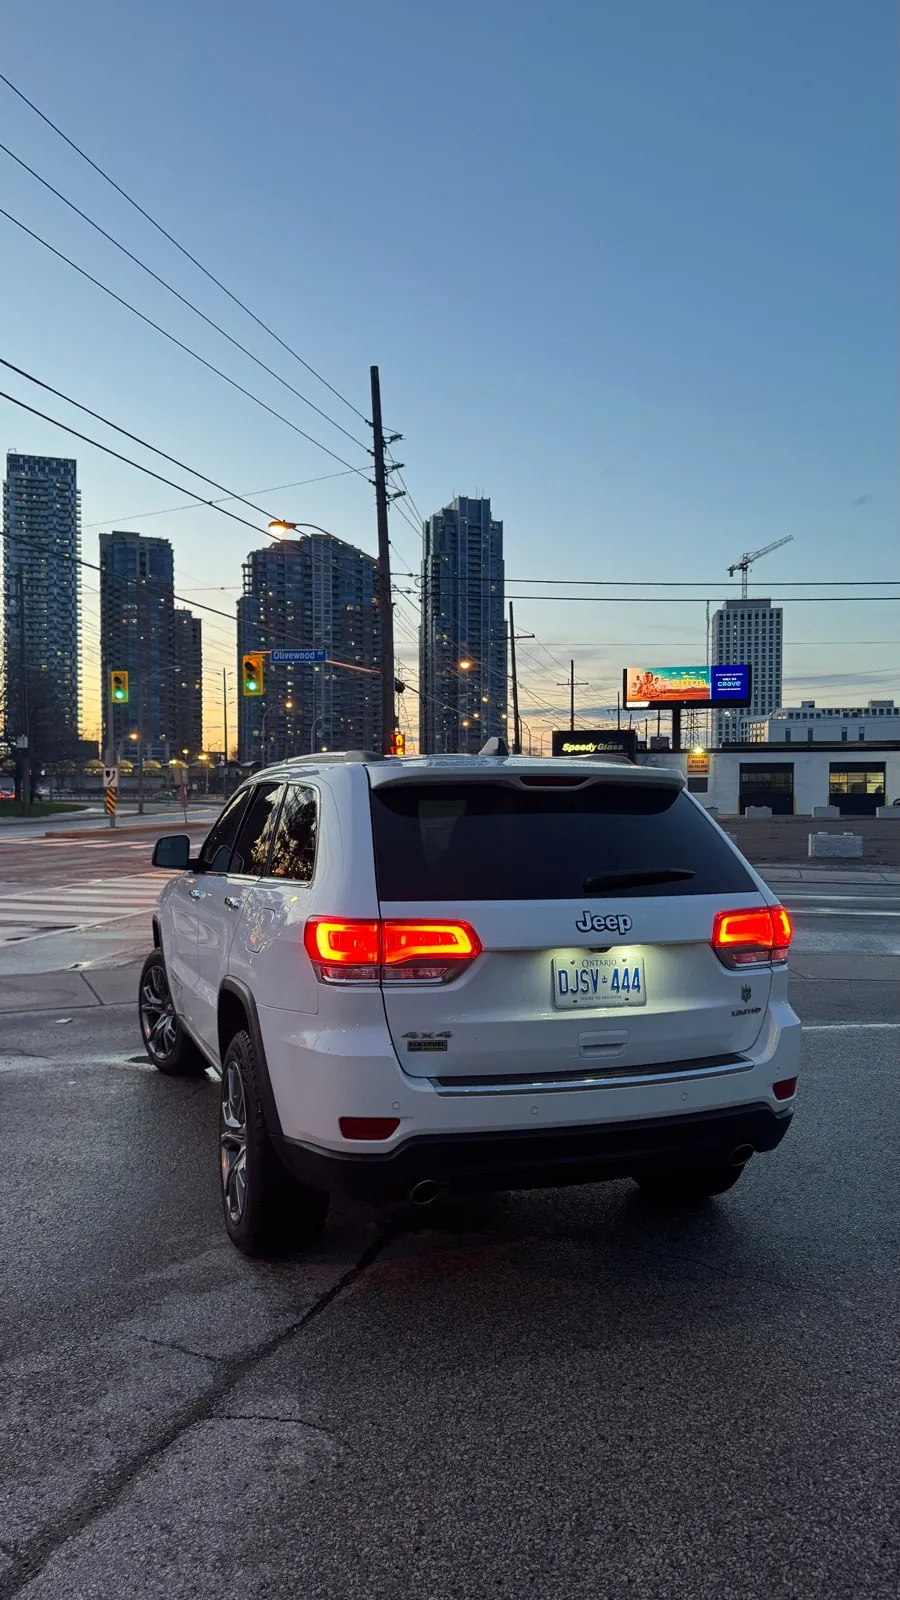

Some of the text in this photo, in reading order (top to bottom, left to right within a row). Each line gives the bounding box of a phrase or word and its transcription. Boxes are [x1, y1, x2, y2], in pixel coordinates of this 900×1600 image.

[273, 651, 315, 659] Olivewood
[562, 743, 623, 752] Speedy Glass
[575, 910, 632, 935] Jeep
[558, 967, 640, 994] DJSV 444
